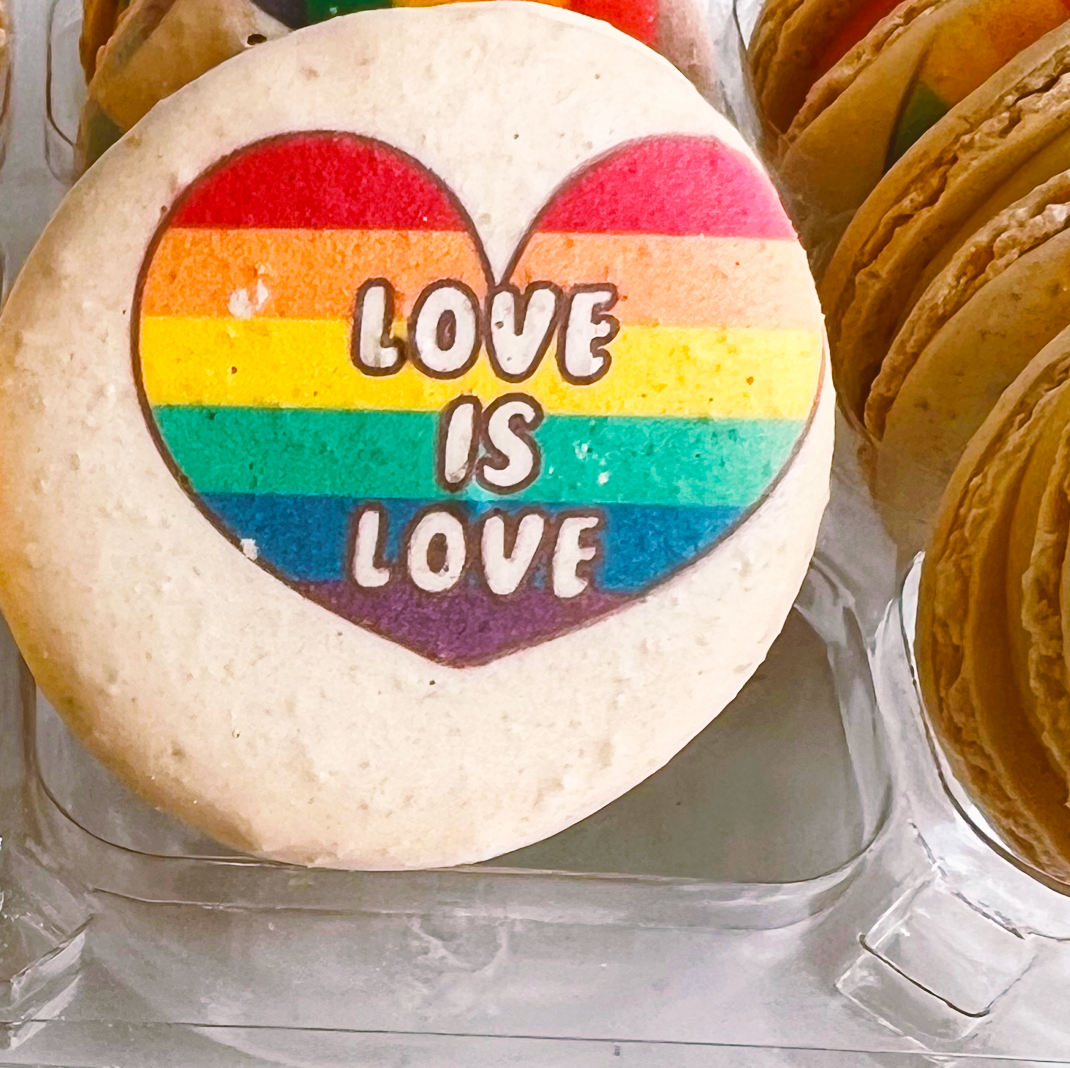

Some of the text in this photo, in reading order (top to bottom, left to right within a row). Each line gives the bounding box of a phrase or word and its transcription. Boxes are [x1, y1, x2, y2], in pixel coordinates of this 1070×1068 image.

[351, 278, 620, 385] LOVE
[437, 393, 544, 494] IS
[349, 505, 603, 601] LOVE
